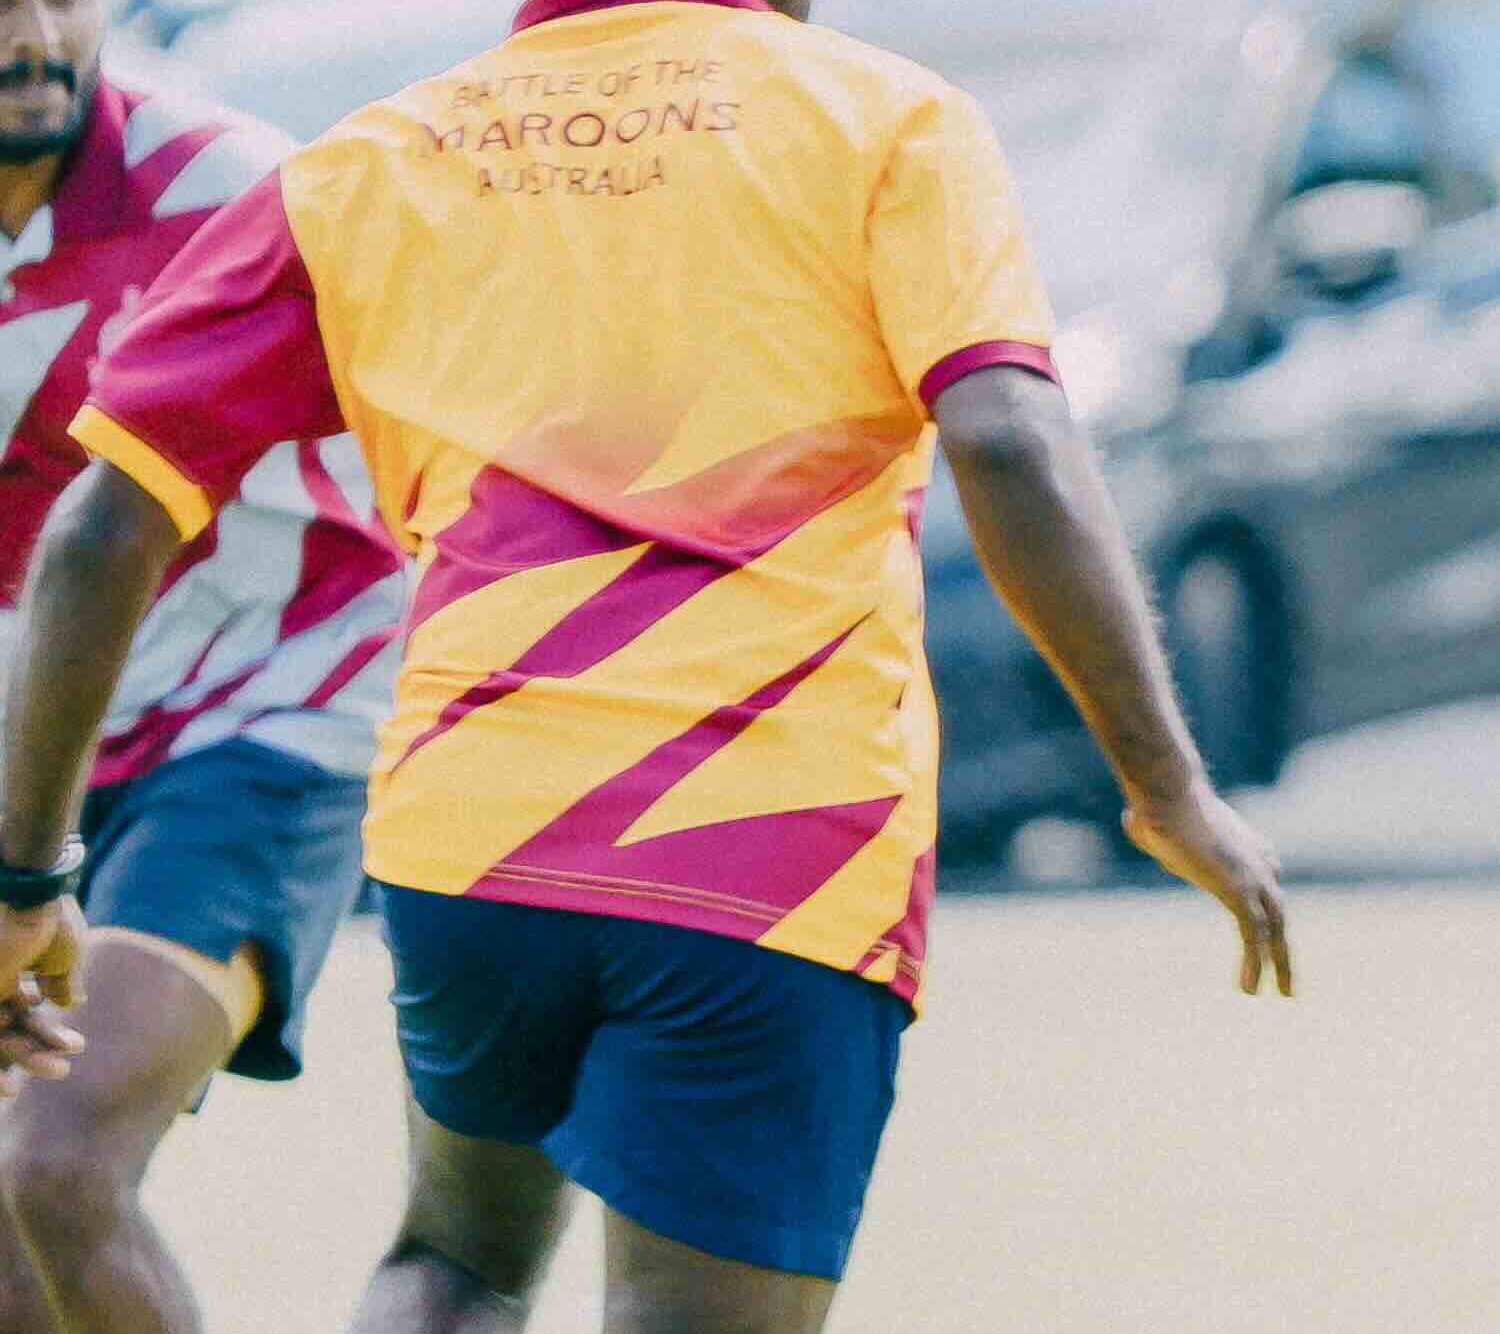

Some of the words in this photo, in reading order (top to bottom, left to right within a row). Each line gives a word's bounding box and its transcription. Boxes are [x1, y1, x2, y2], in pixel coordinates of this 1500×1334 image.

[452, 74, 585, 108] BATTLE
[598, 64, 640, 96] OF
[656, 60, 722, 85] THE
[422, 98, 741, 153] MAROONS
[478, 156, 666, 196] AUSTRALIA
